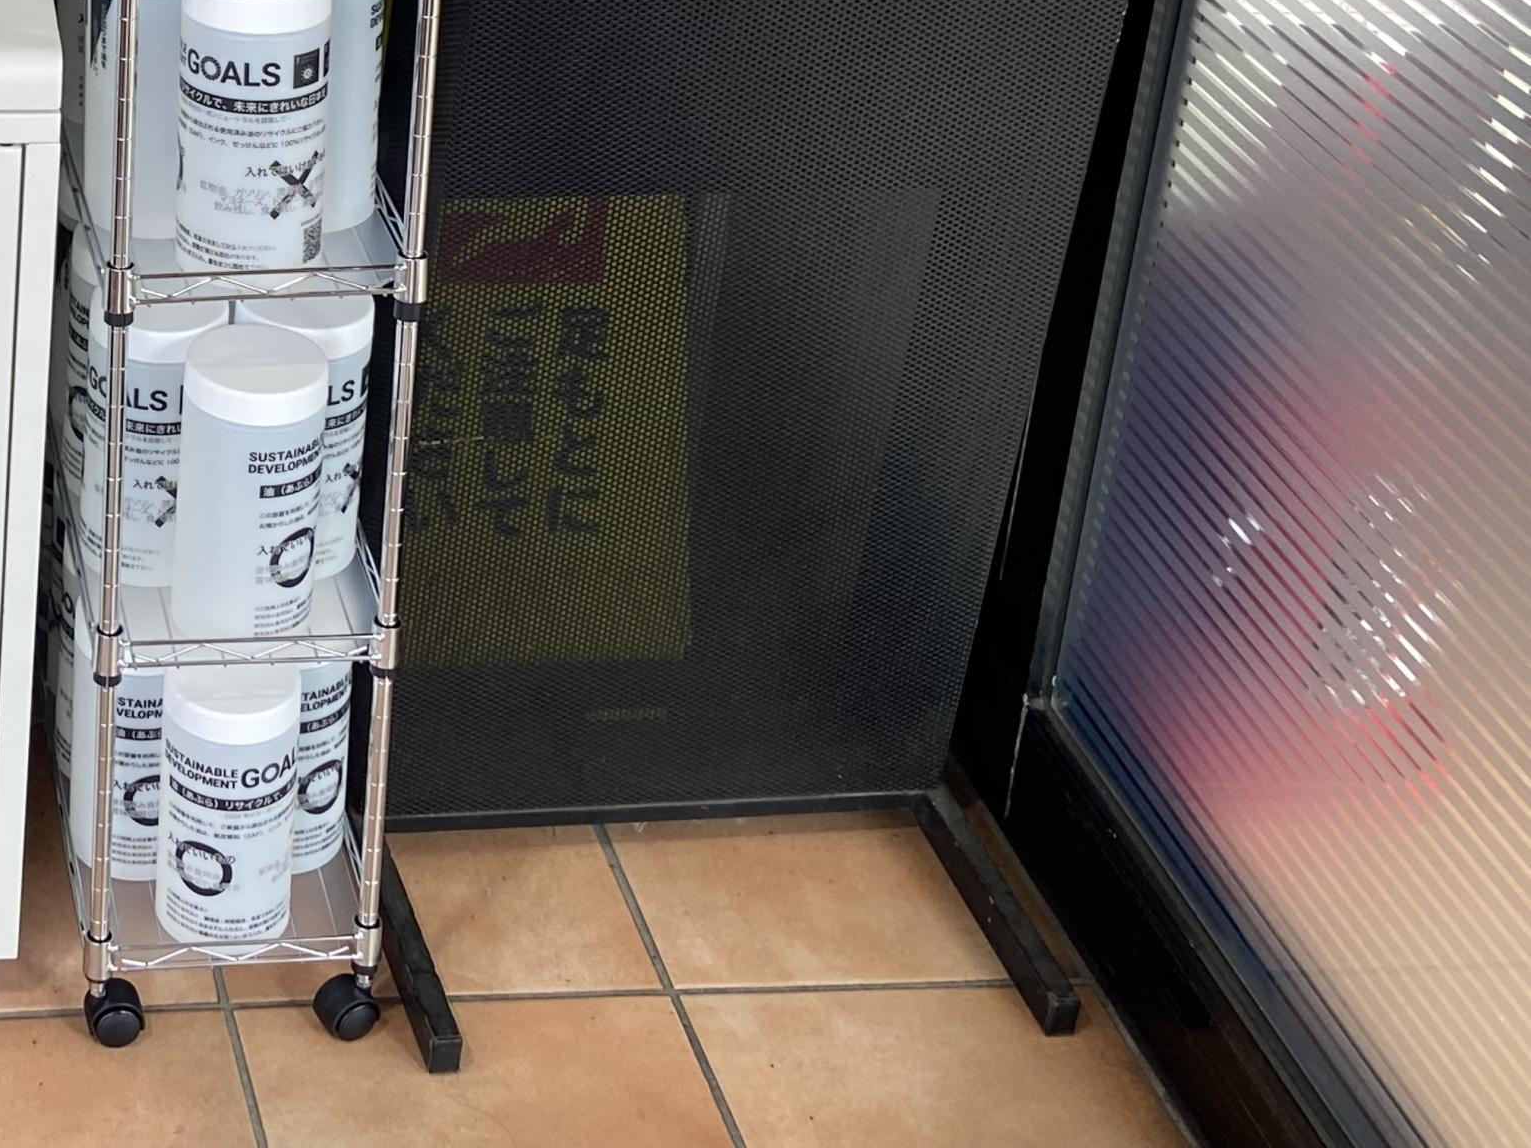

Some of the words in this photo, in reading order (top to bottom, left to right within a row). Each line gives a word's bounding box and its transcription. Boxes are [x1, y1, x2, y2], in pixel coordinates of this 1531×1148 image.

[188, 48, 281, 87] GOALS
[164, 749, 238, 790] DEVELOPMENT
[165, 738, 239, 779] SUSTAINABLE
